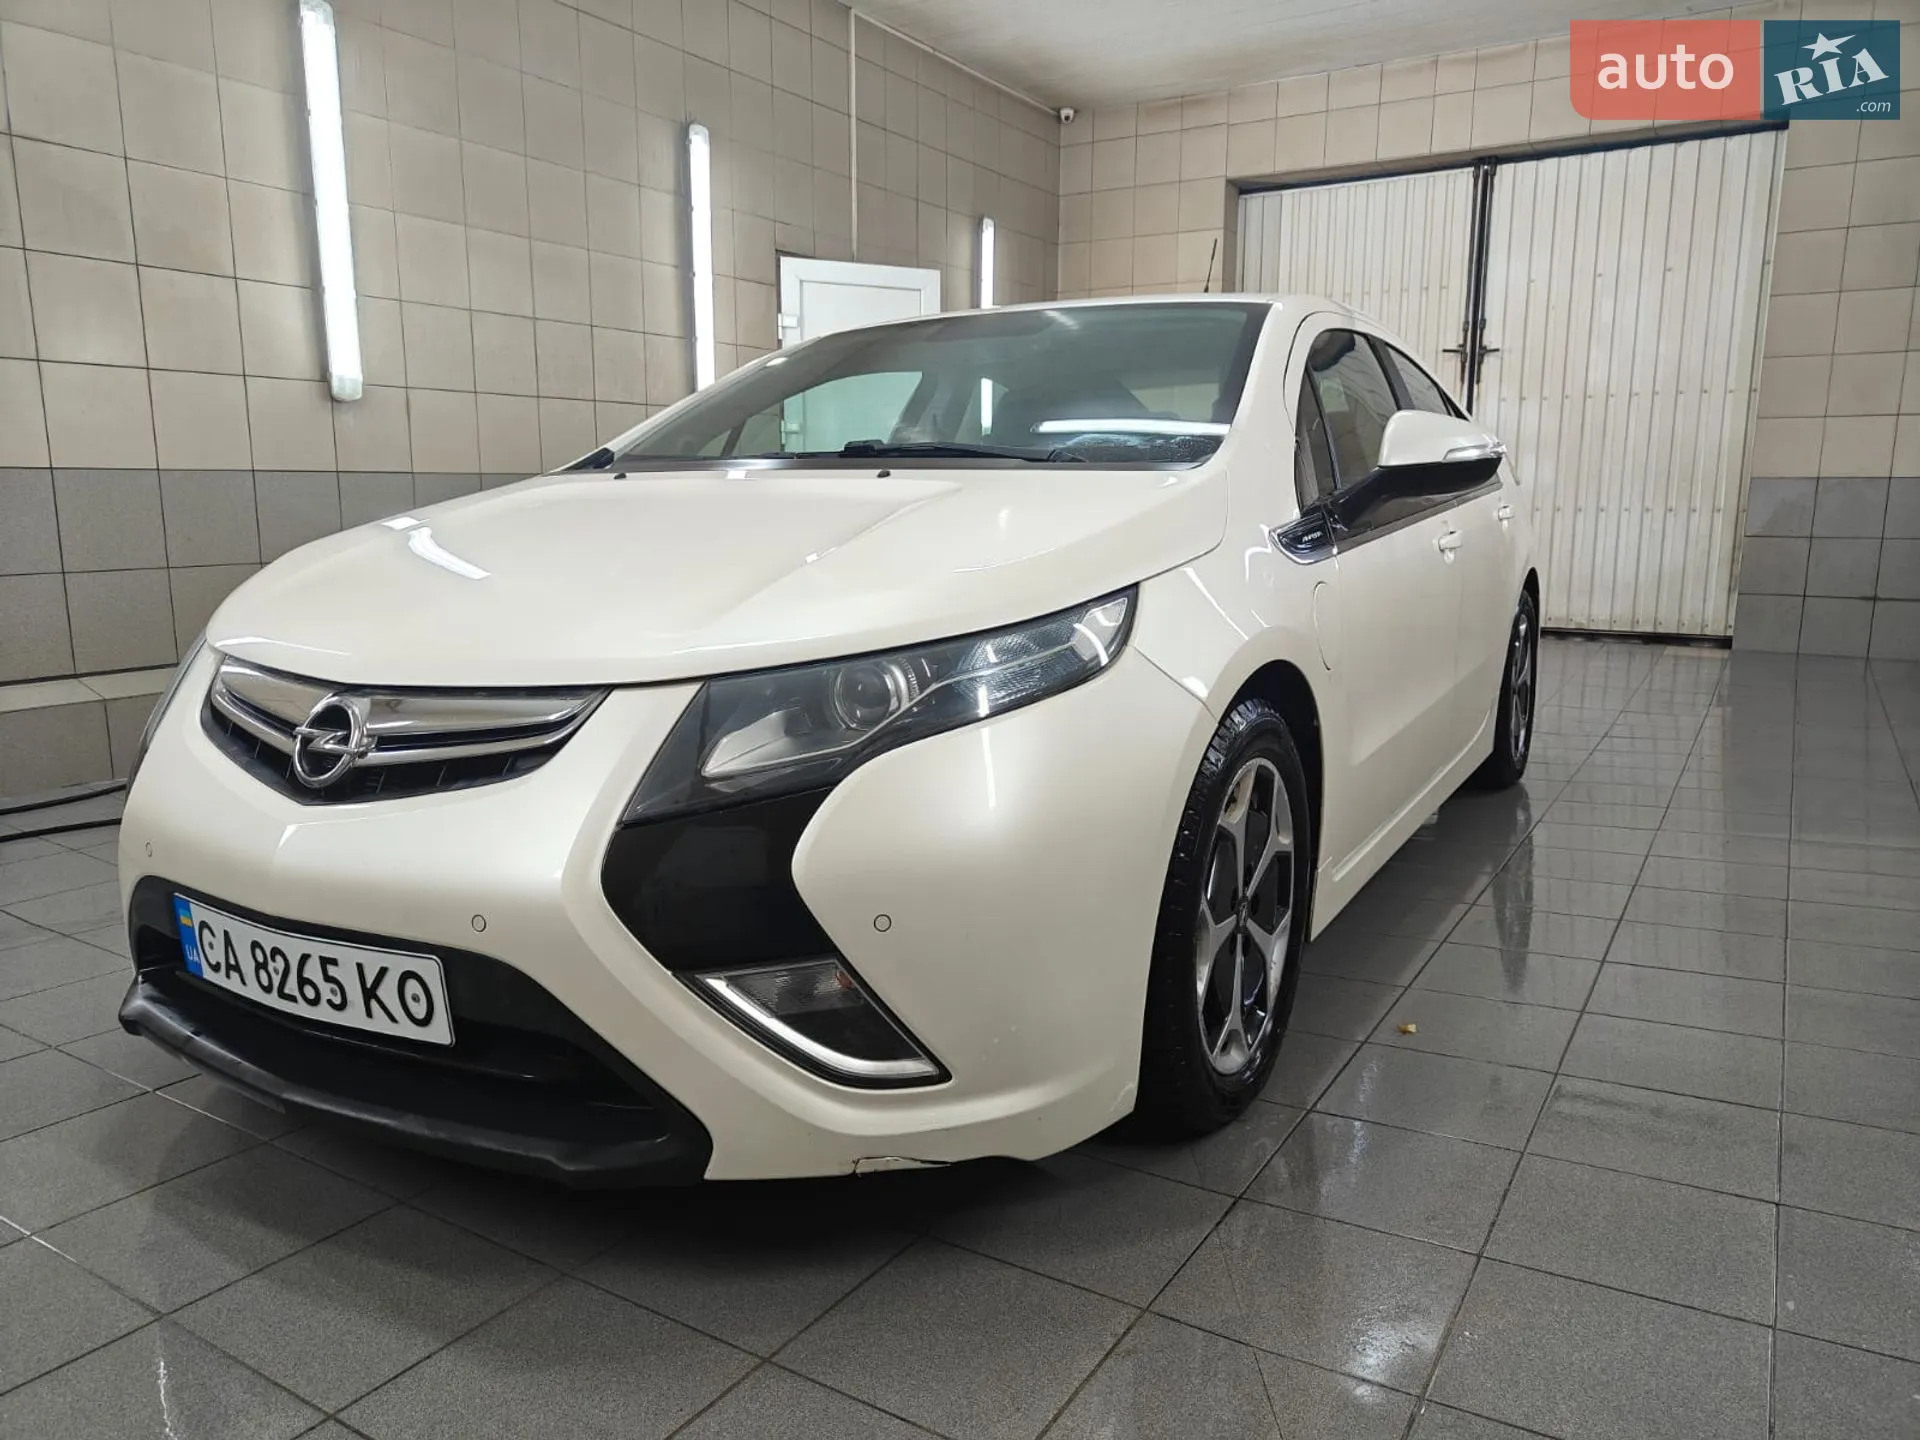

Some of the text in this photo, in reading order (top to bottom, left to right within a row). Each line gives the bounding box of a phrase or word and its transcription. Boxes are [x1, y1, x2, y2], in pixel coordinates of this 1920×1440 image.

[185, 944, 200, 963] UA
[198, 920, 434, 1027] CA 8265 KO
